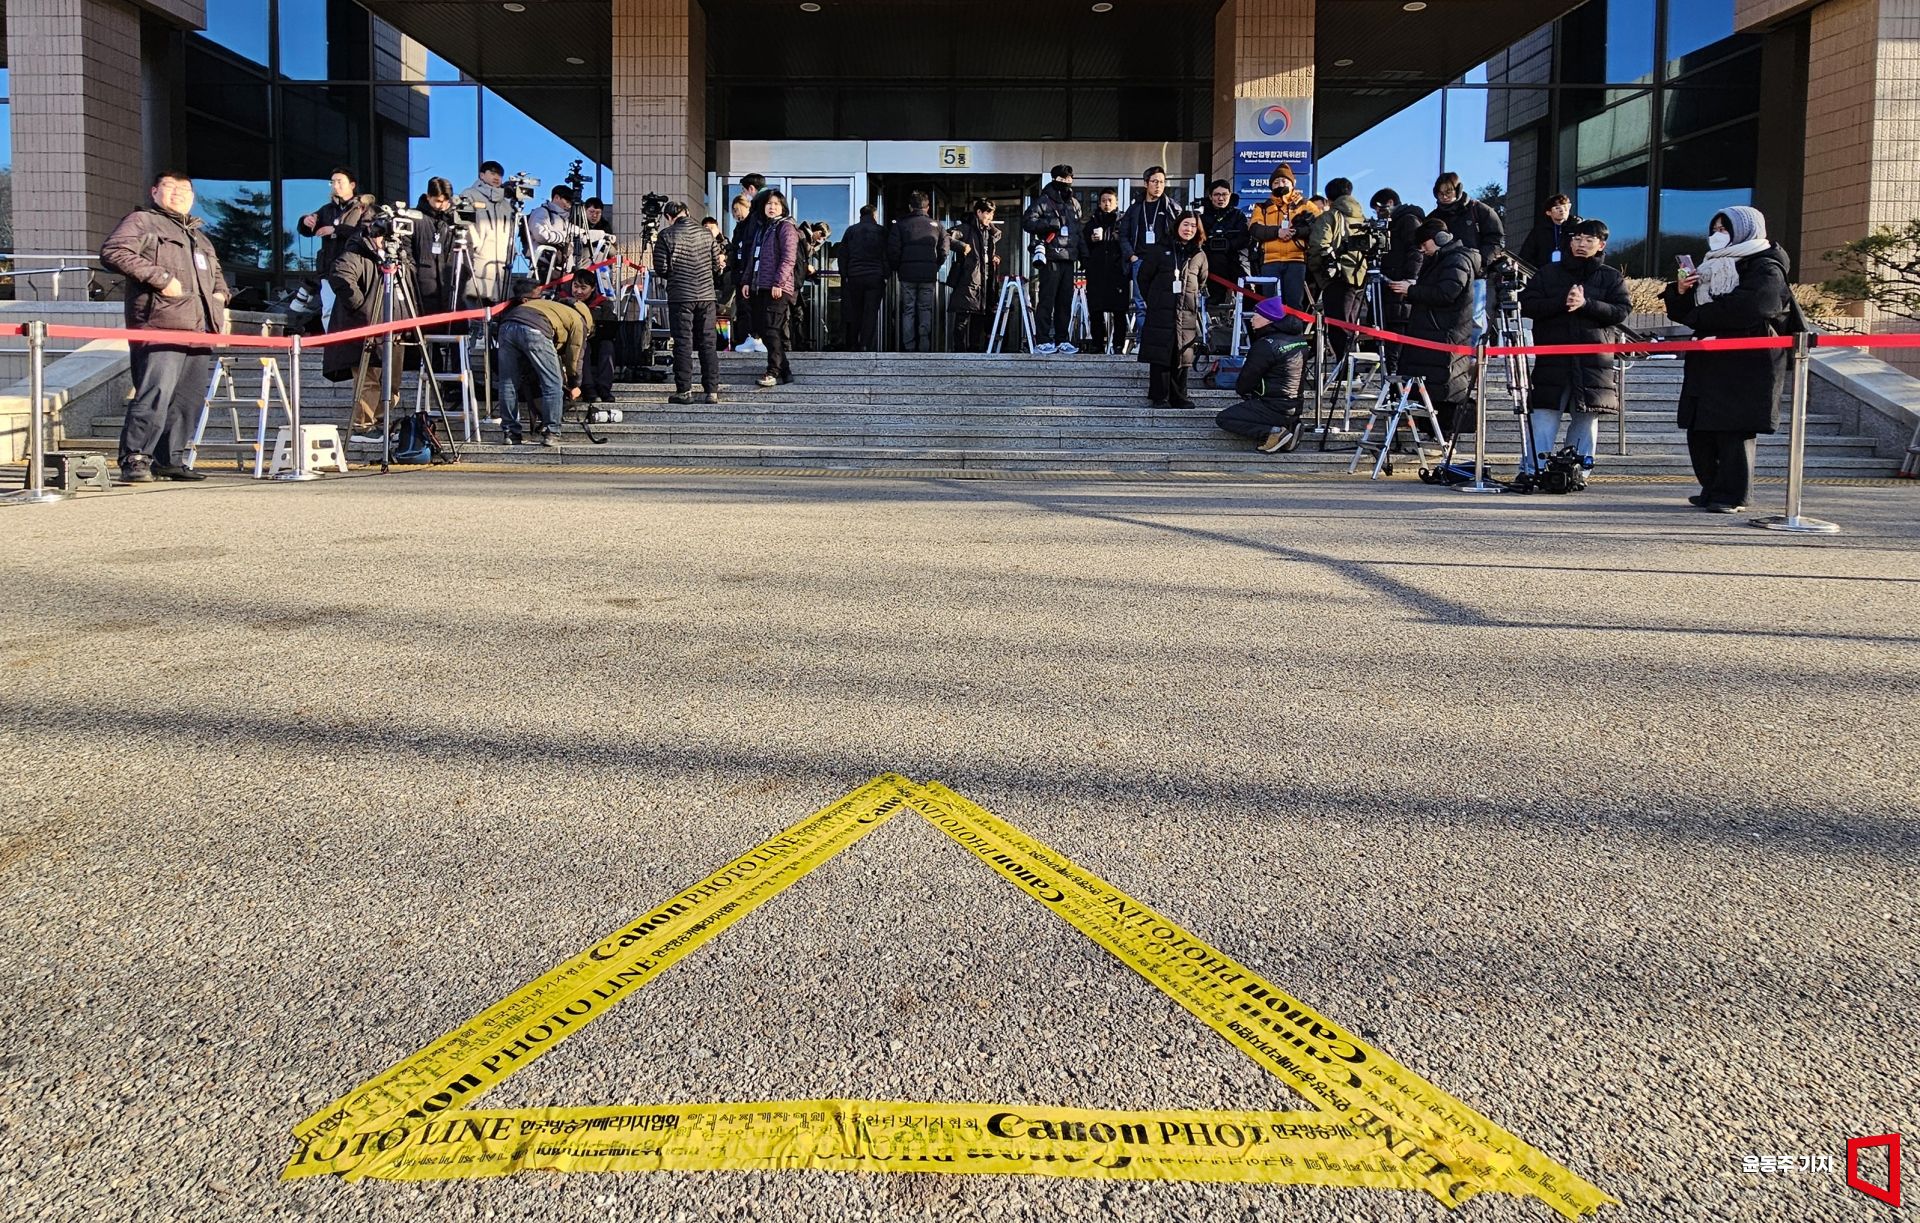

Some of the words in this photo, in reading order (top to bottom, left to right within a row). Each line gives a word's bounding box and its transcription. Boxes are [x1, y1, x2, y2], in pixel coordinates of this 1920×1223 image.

[1248, 178, 1270, 187] 경인지
[910, 795, 952, 823] LINE
[940, 817, 997, 861] PHOTO
[590, 901, 690, 963] Canon
[683, 859, 758, 905] PHOTO
[755, 833, 801, 864] LINE
[993, 853, 1066, 904] Canon
[1099, 891, 1153, 930] LINE
[482, 998, 593, 1075] PHOTO
[590, 957, 658, 1002] LINE
[856, 795, 902, 824] Cano
[1151, 926, 1245, 987] PHOTO
[1243, 982, 1367, 1064] Canon
[417, 1116, 516, 1146] LINE
[519, 1113, 681, 1136] 한국방송카메라기자협회
[986, 1111, 1150, 1145] Canon
